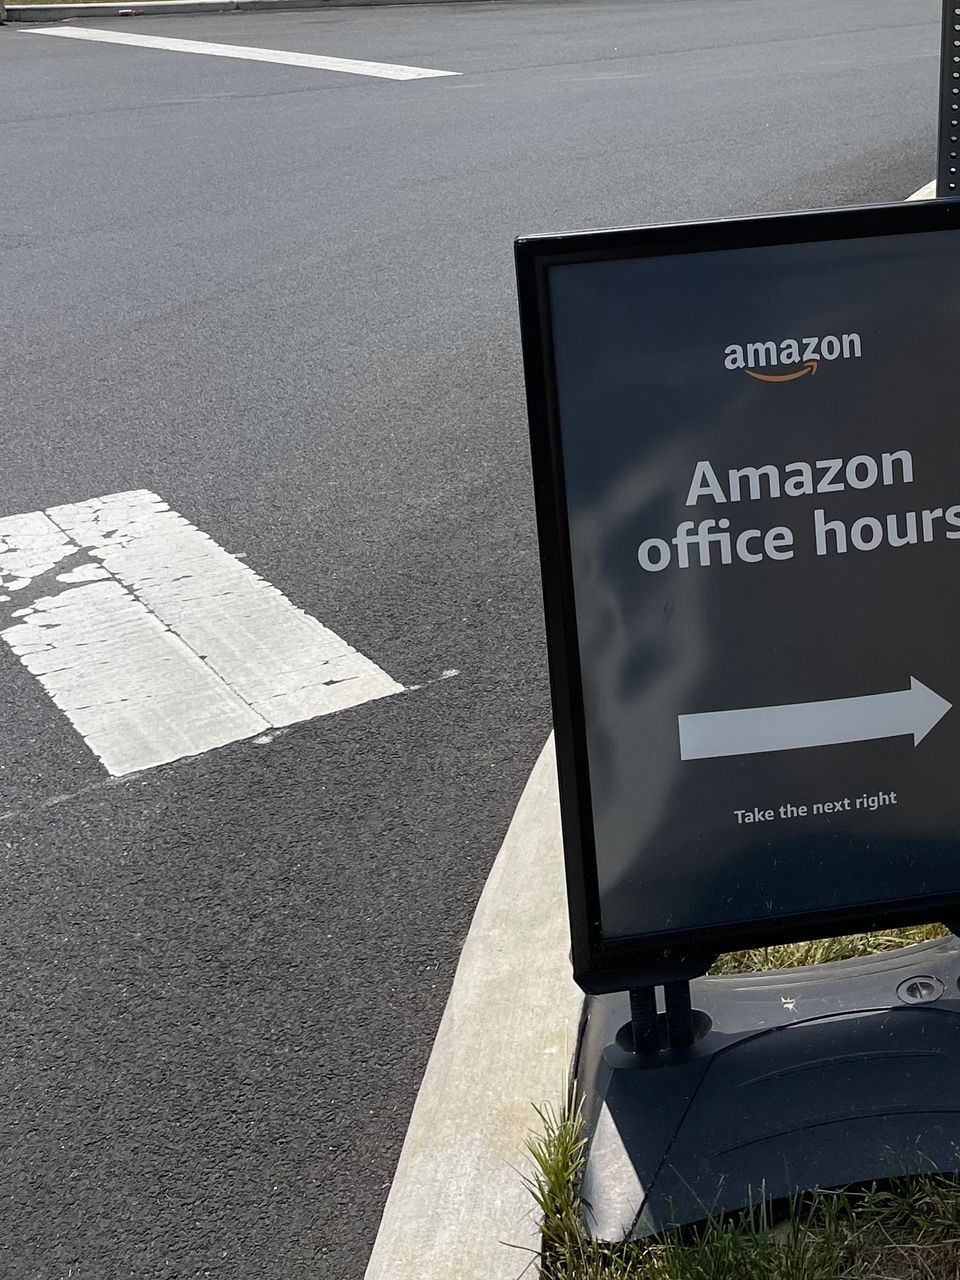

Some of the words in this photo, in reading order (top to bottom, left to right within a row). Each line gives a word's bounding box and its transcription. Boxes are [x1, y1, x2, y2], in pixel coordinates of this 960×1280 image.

[724, 331, 862, 370] amazon
[685, 448, 914, 507] Amazon
[637, 518, 794, 572] office
[734, 807, 774, 824] Take
[779, 804, 808, 819] the
[812, 797, 851, 815] next
[856, 791, 897, 812] right
